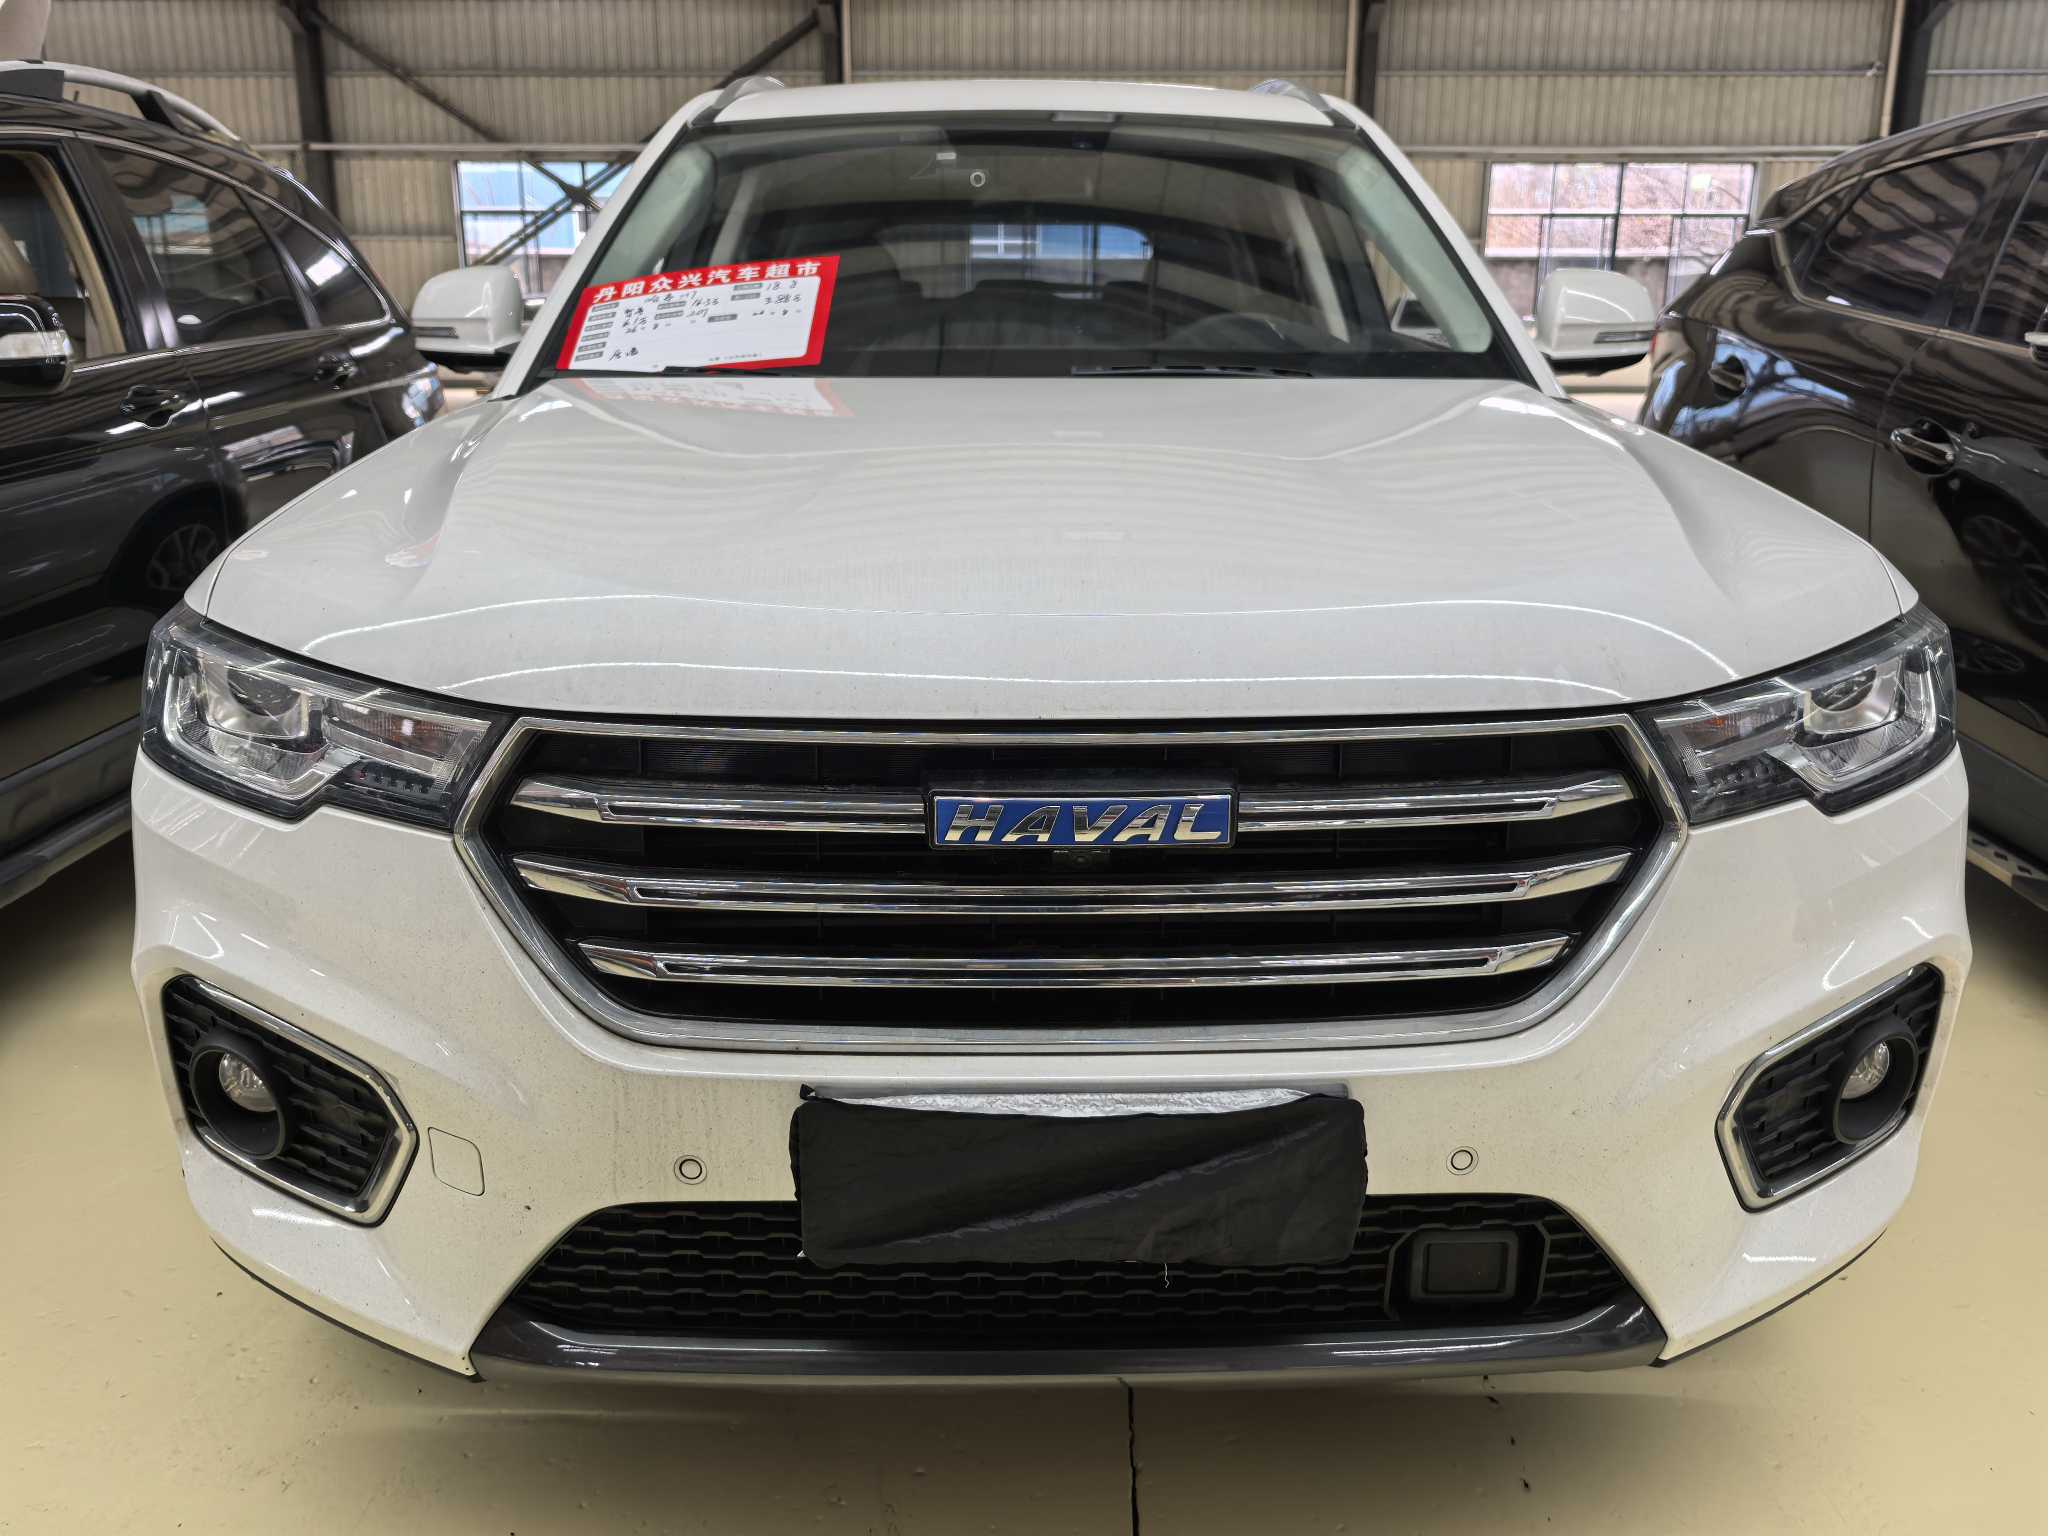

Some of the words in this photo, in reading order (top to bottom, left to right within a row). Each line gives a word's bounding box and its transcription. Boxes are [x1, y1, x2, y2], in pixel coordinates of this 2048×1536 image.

[593, 261, 821, 304] 丹阳众兴汽车超市
[944, 804, 1222, 842] HAVAL
